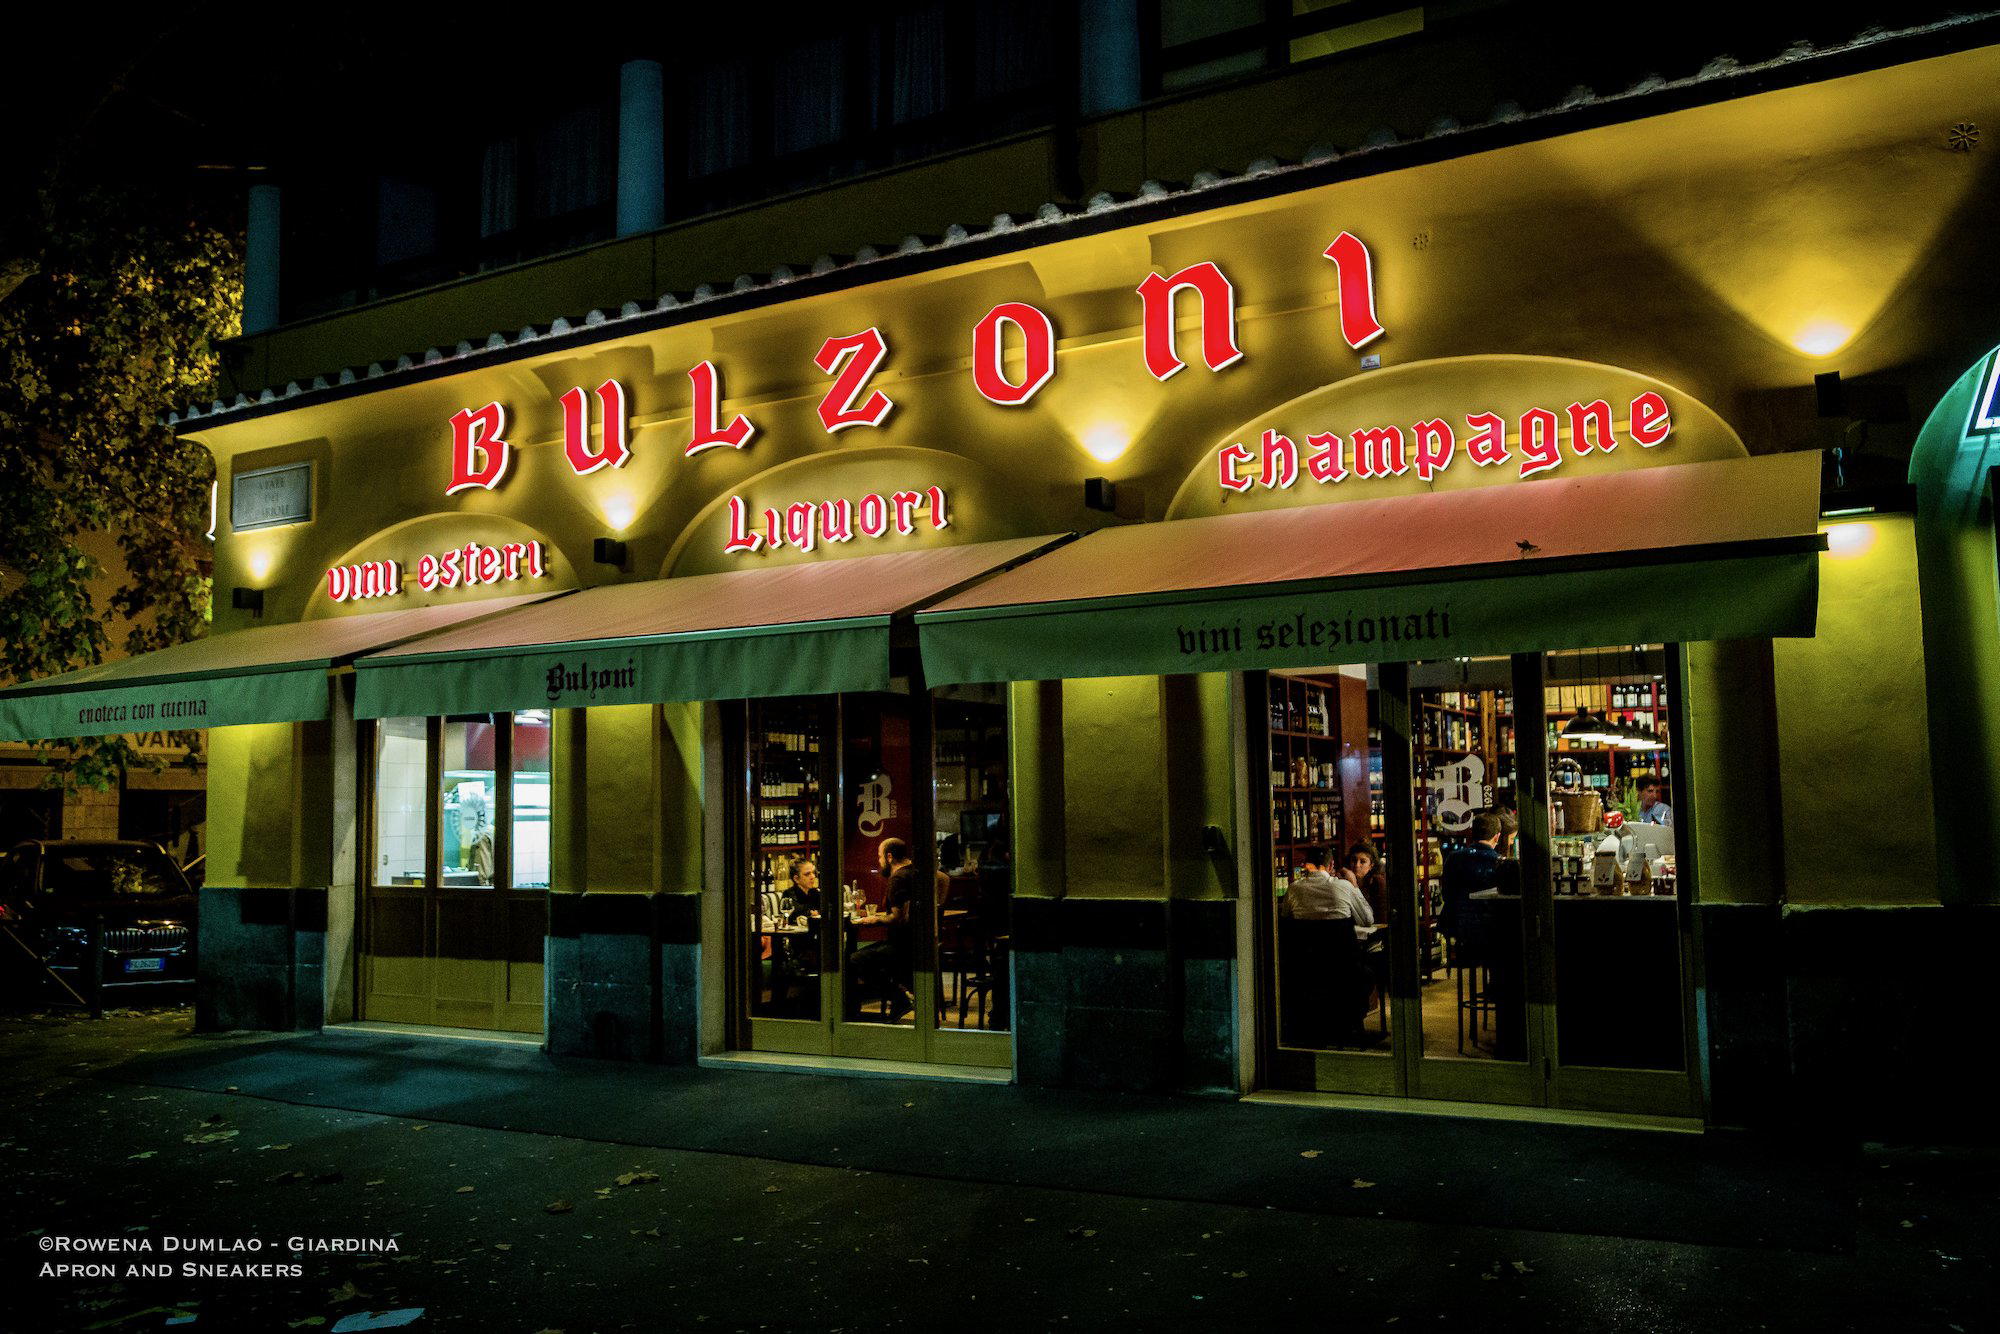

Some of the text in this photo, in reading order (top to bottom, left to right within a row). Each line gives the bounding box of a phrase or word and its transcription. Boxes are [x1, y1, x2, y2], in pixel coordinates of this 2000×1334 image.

[1218, 391, 1671, 491] champagne
[724, 486, 947, 553] Liquori
[326, 540, 544, 602] vini esteri
[1177, 603, 1451, 655] vini selezionati
[546, 658, 635, 700] Bulzoni
[79, 699, 207, 724] enoteca con cucina
[1483, 785, 1494, 808] 1929
